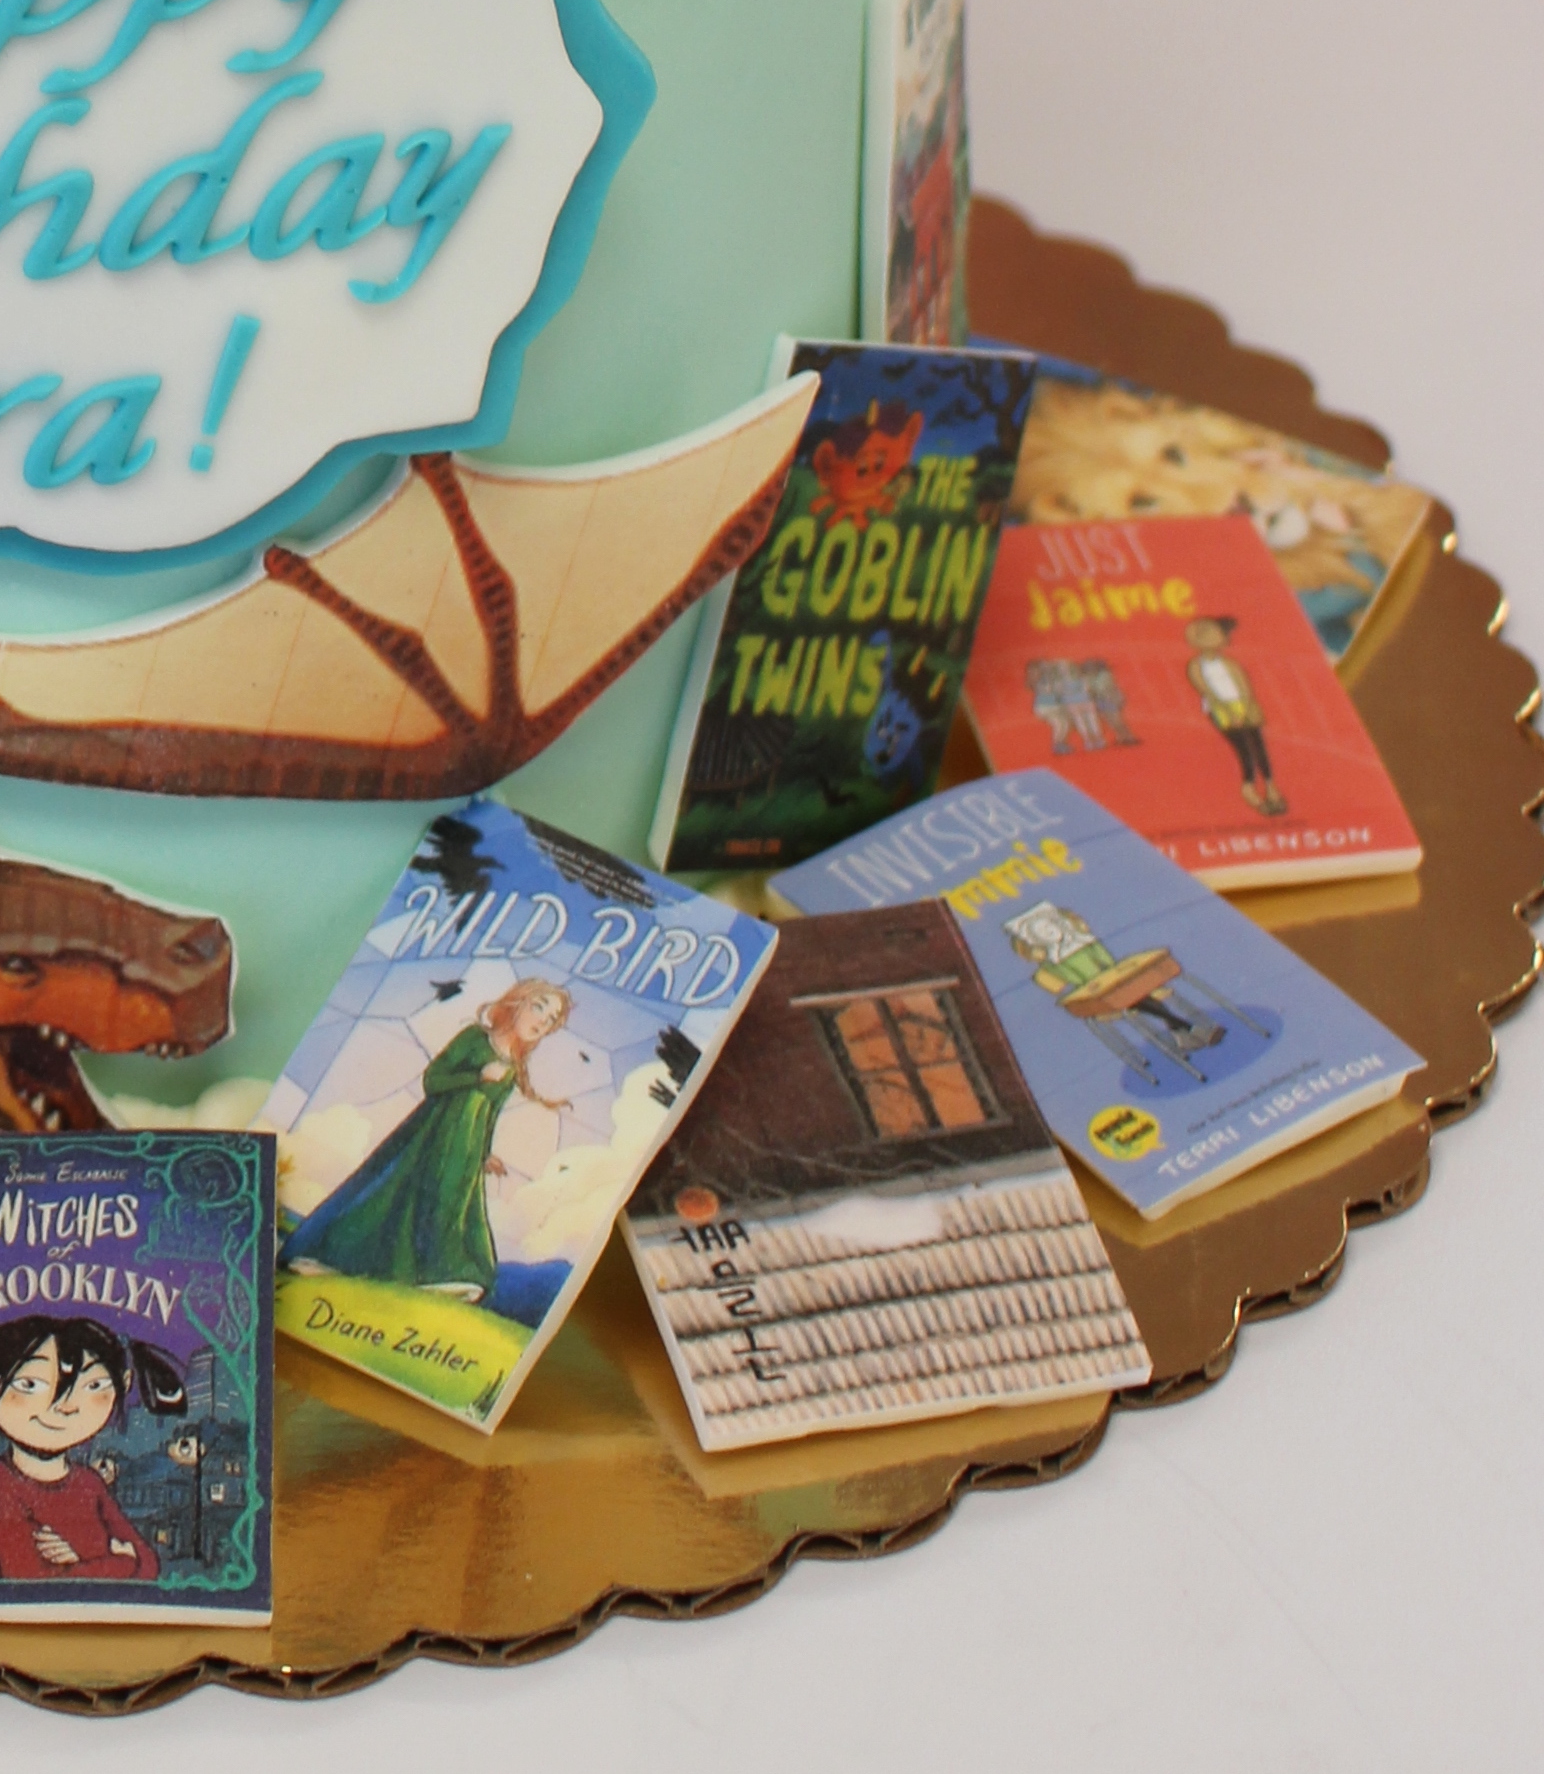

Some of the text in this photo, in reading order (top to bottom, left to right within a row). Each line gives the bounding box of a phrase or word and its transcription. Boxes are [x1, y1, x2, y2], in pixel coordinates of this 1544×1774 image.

[917, 455, 977, 511] THE
[761, 515, 989, 627] GOBLIN
[1037, 525, 1153, 581] JUST
[1027, 578, 1196, 633] Jaime
[728, 633, 888, 718] TWINS
[826, 780, 1063, 907] INVISIBLE
[938, 837, 1083, 919] mmie
[1198, 826, 1370, 858] LIBENSON
[394, 884, 741, 1007] WILD BIRD
[1157, 1123, 1241, 1180] TERRI
[1248, 1053, 1385, 1128] LIBENSON
[47, 1240, 81, 1260] of
[304, 1297, 480, 1375] Diane Zahler
